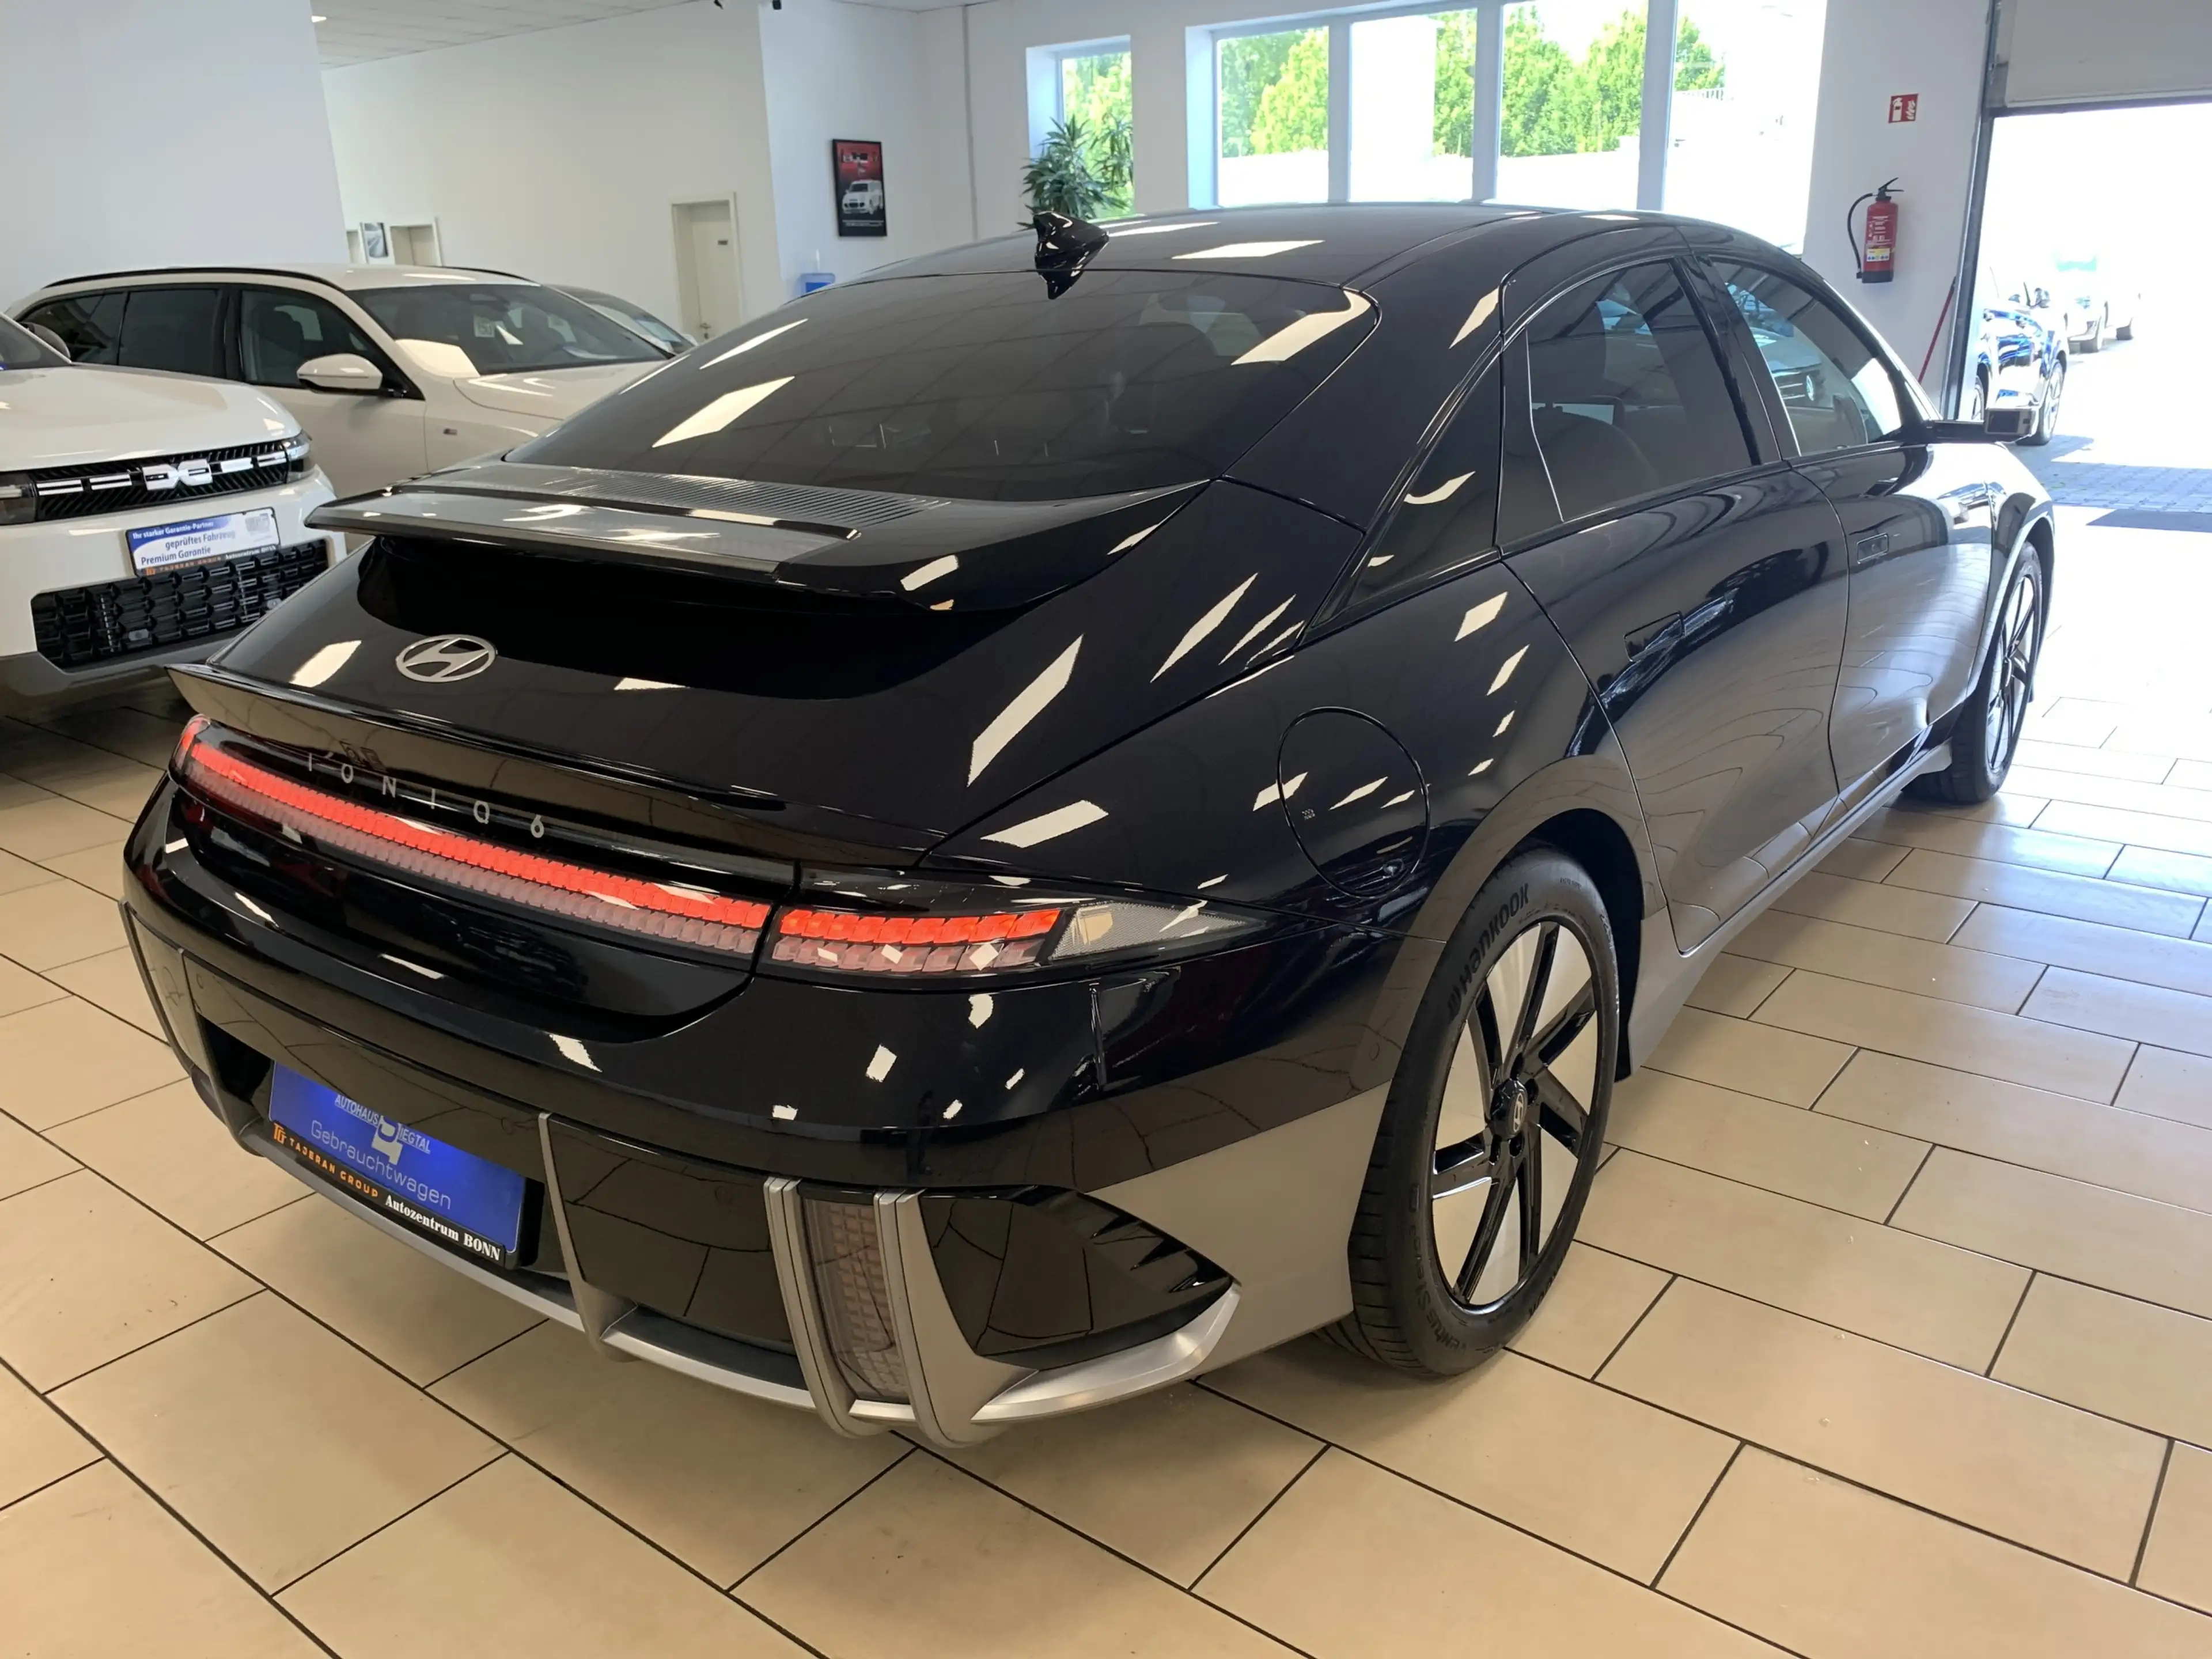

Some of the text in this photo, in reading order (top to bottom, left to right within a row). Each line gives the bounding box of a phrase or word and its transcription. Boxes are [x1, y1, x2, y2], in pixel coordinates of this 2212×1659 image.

[132, 531, 142, 540] Ihr
[143, 529, 164, 539] starker
[165, 536, 202, 551] geprüftes
[141, 546, 211, 566] Premium Garantie
[530, 814, 545, 839] 6
[334, 1094, 379, 1124] AUTOHAUS
[311, 1120, 451, 1210] Gebrauchtwagen
[290, 1138, 336, 1174] TAJERAN
[340, 1171, 378, 1197] GROUP
[385, 1194, 459, 1242] Autozentrum
[463, 1233, 501, 1261] BONN
